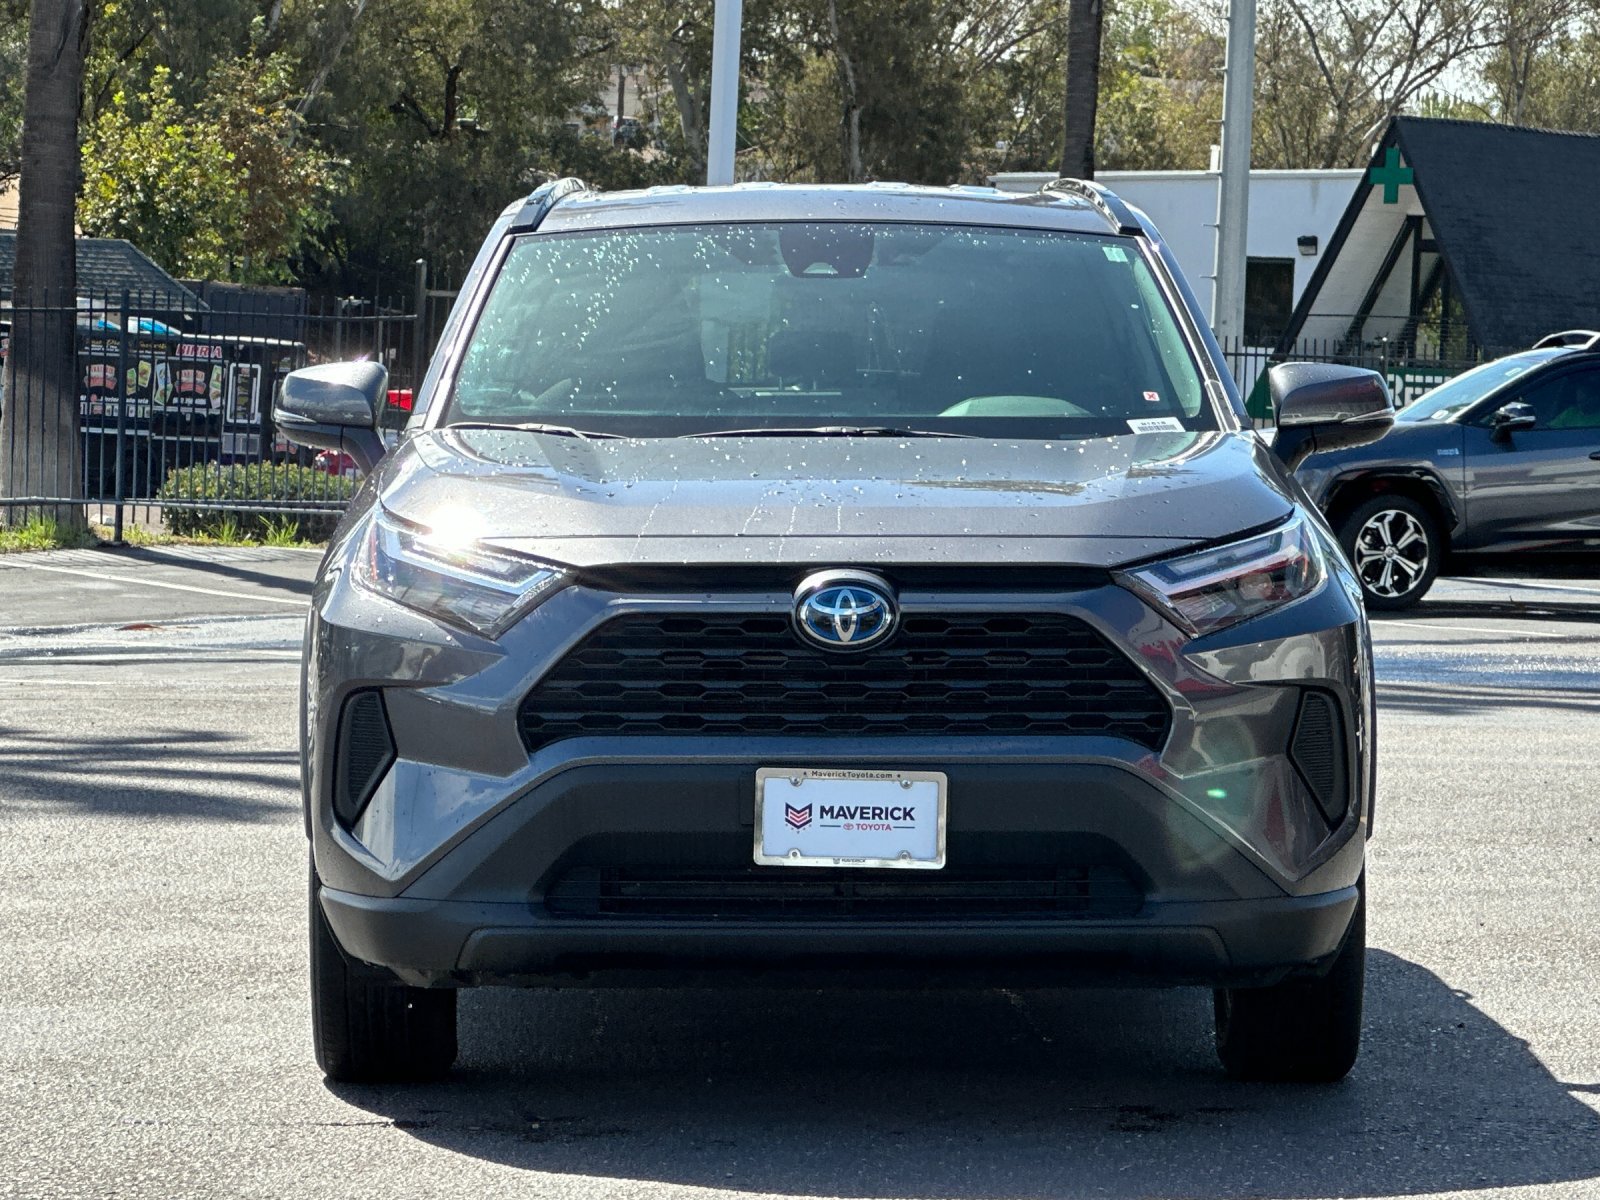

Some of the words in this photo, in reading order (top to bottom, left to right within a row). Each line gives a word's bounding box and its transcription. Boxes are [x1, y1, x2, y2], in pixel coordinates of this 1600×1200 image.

[811, 770, 893, 779] MaverickToyota.com
[819, 805, 916, 821] MAVERICK
[855, 823, 892, 831] TOYOTA
